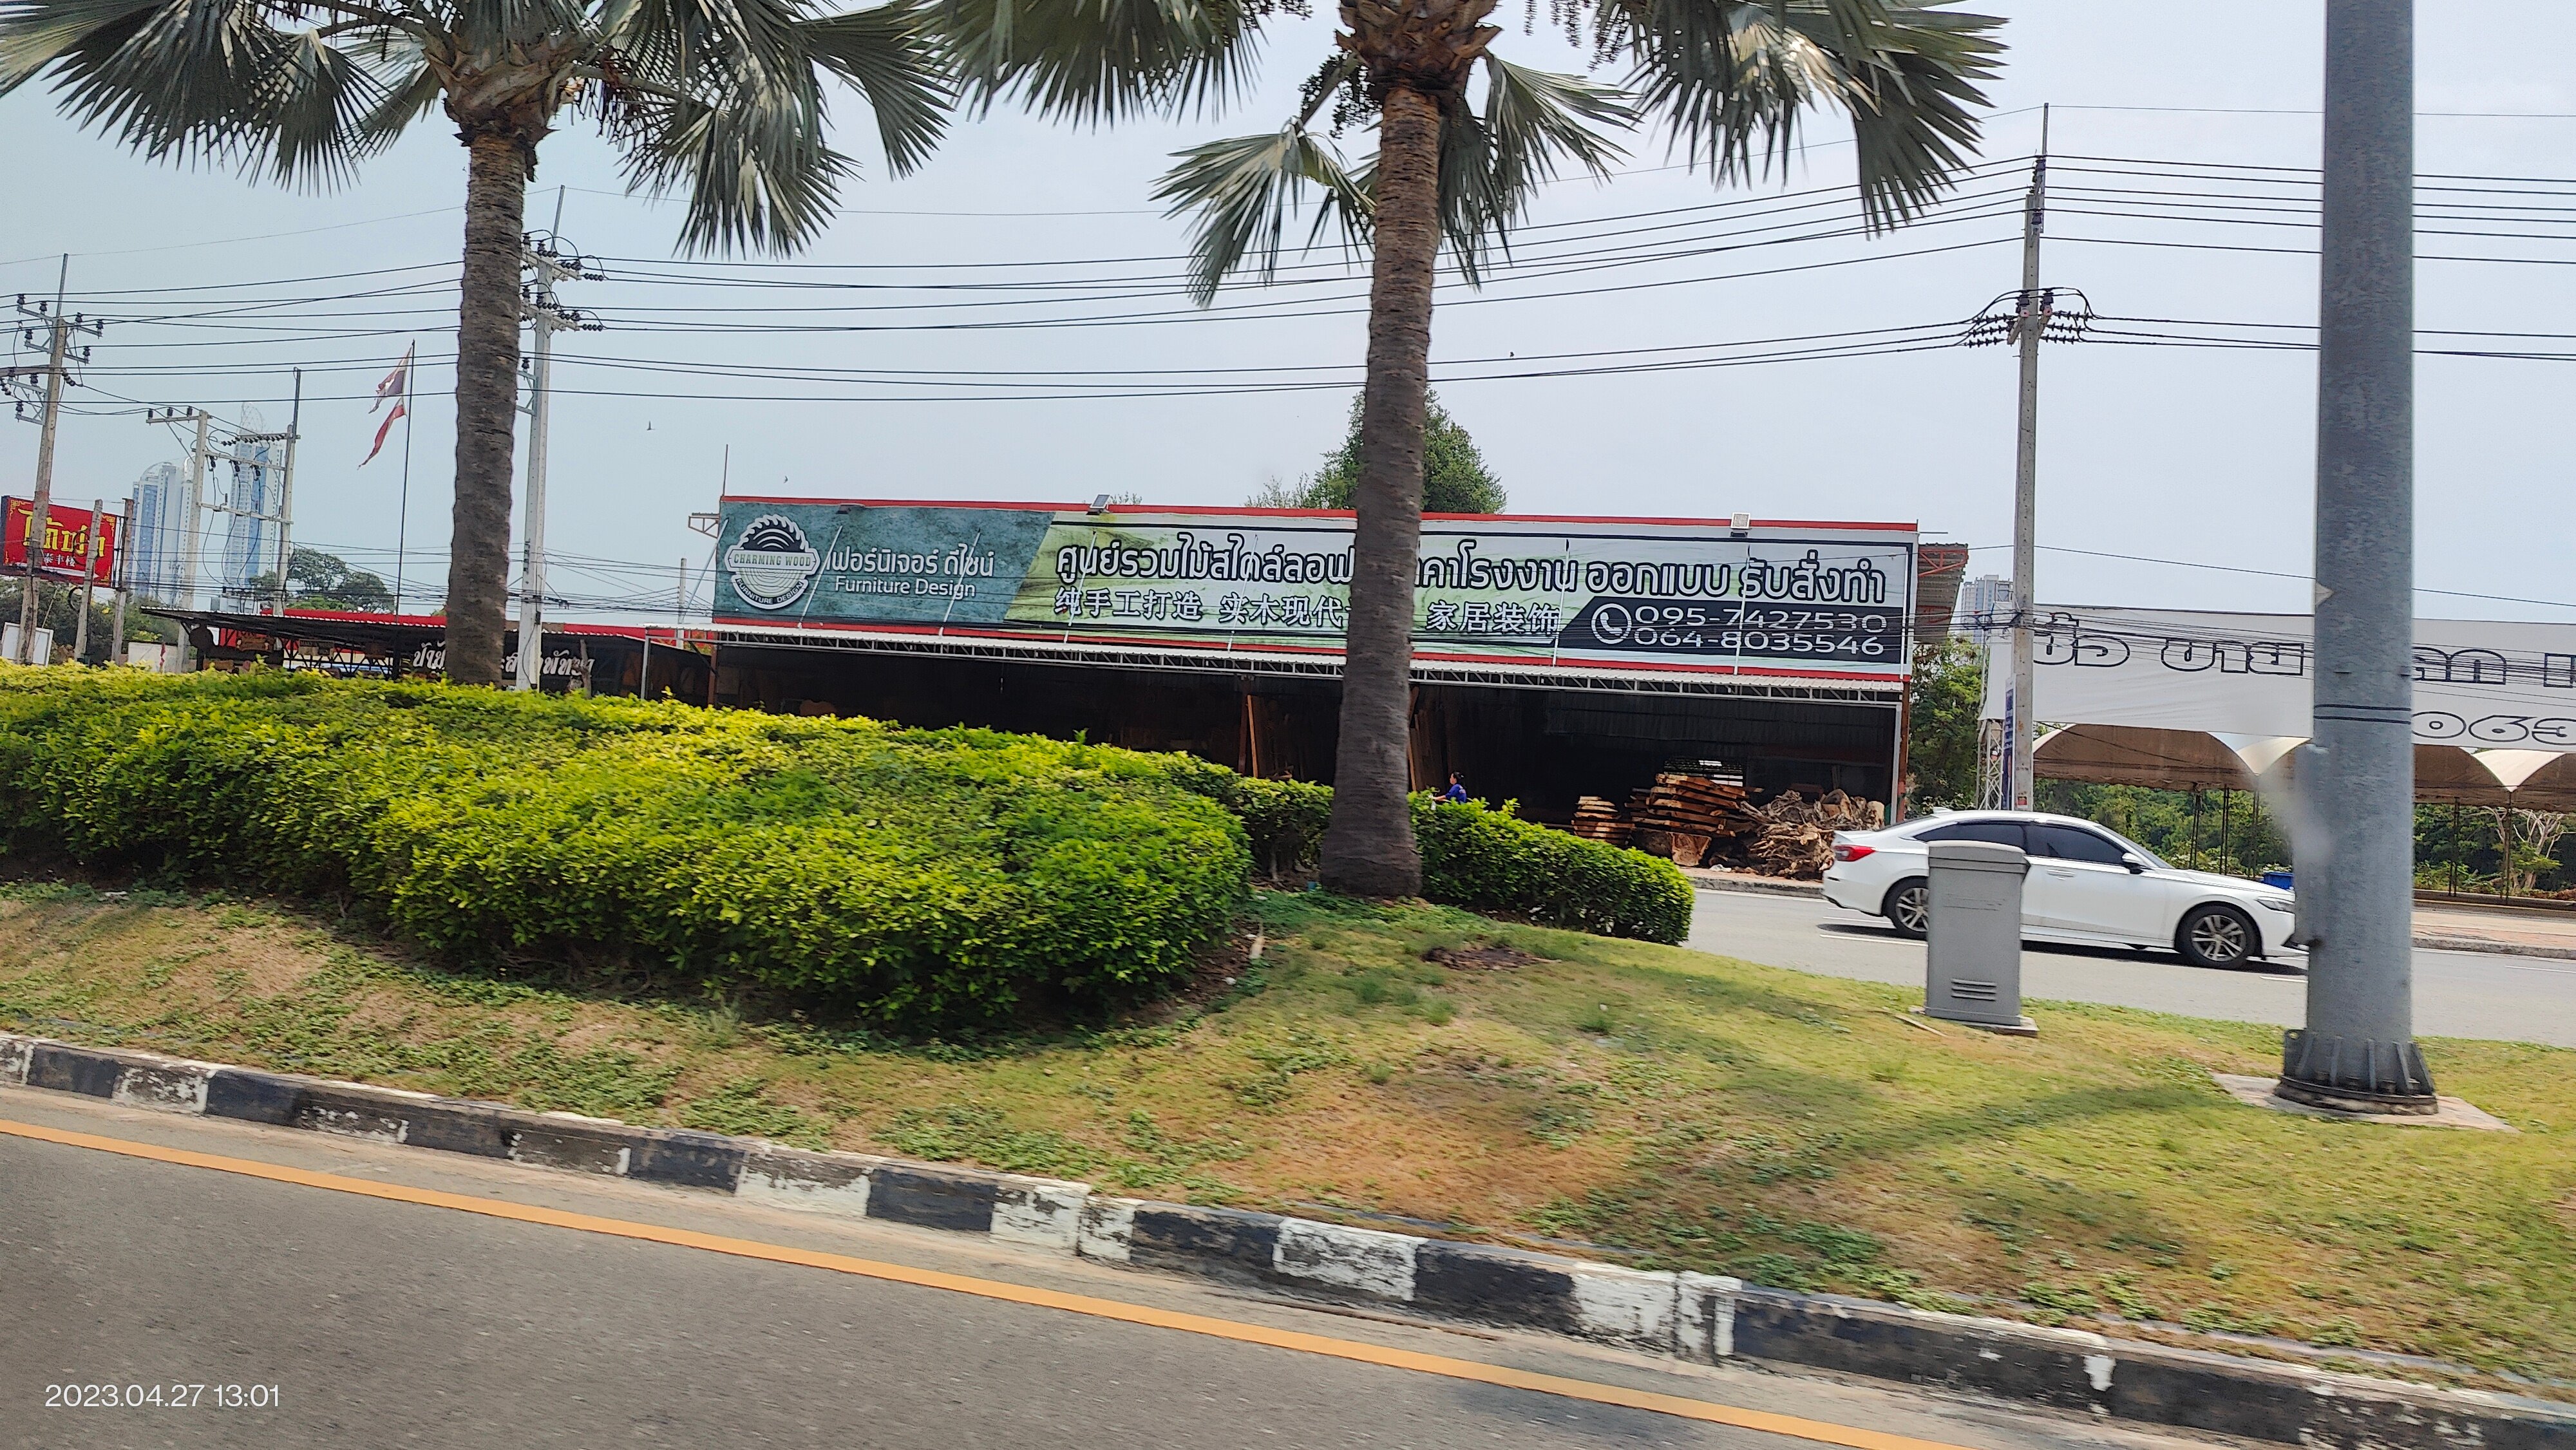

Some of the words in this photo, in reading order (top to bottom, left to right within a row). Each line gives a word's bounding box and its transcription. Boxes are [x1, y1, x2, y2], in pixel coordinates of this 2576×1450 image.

[734, 553, 782, 566] CHARMING
[786, 556, 811, 567] WOOD
[826, 546, 940, 574] เฟอร์นิเจอร์
[1056, 532, 1356, 585] ศูนย์รวมไม้สไตล์ลอฟ
[1587, 560, 1730, 597] ออกแบบ
[1740, 549, 1886, 603] รับสั่งทำ
[736, 579, 774, 605] FURNITURE
[776, 581, 804, 603] DESIGN
[835, 576, 911, 595] Furniture
[914, 578, 976, 600] Design
[1054, 587, 1202, 621] 纯手工打造
[1218, 592, 1352, 628] 实木现代
[1426, 599, 1561, 634] 家居装饰
[1635, 605, 1887, 633] 095-7427530
[1634, 627, 1884, 655] 064-8035546
